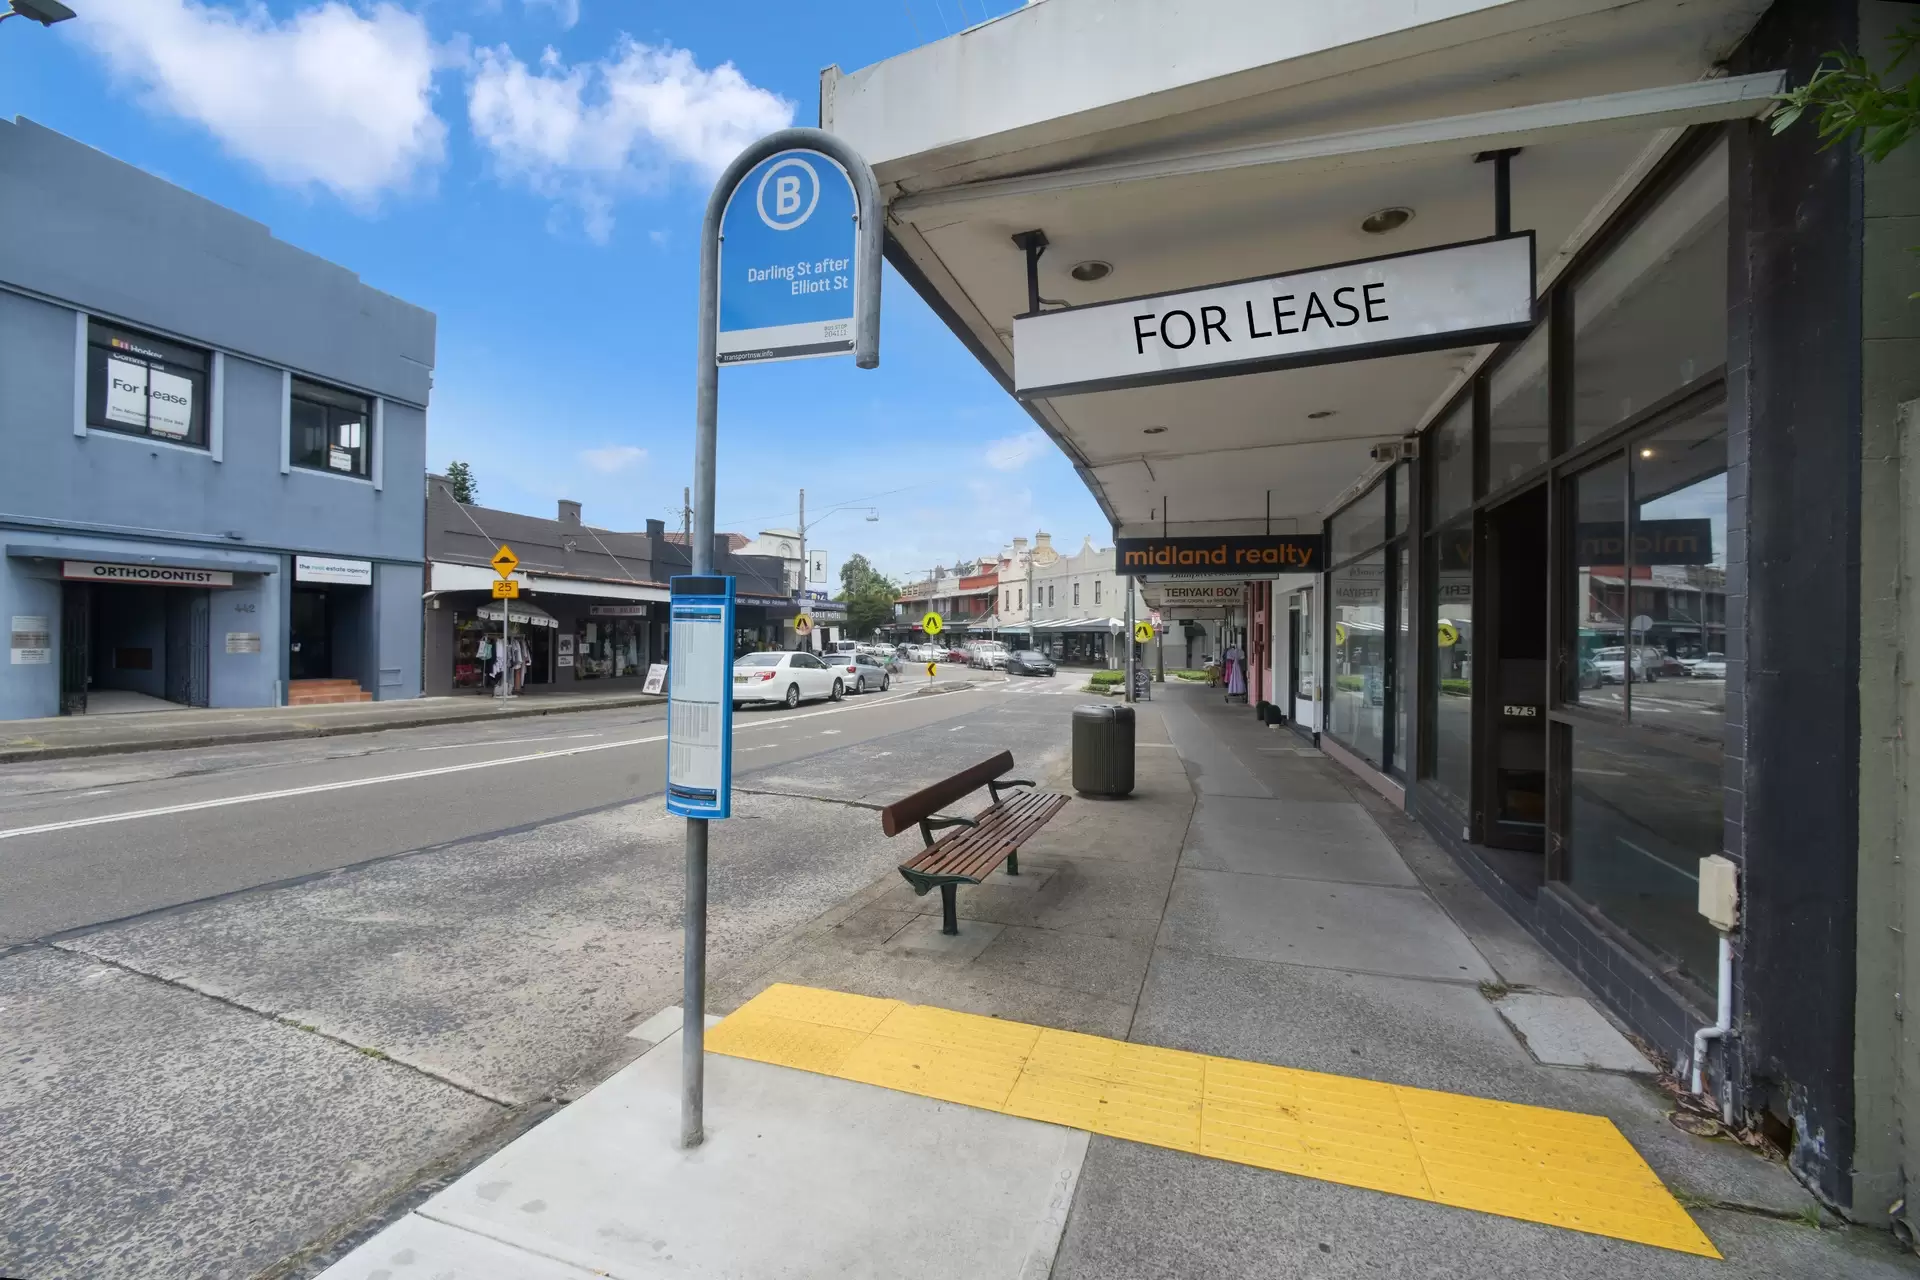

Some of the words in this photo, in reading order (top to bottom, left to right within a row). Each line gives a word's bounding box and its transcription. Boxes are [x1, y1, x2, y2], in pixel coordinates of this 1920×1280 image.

[776, 175, 801, 216] B
[748, 265, 795, 282] Darling
[797, 261, 811, 276] St
[814, 258, 849, 274] after
[791, 279, 830, 295] Elliott
[833, 275, 848, 290] St
[1133, 305, 1232, 354] FOR
[1246, 282, 1389, 338] LEASE
[130, 344, 164, 359] Hooker
[724, 350, 774, 361] transportnsw.info
[113, 378, 139, 393] For
[144, 385, 187, 406] Lease
[1125, 545, 1227, 565] midland
[1235, 543, 1312, 567] realty
[93, 565, 212, 582] ORTHODONTIST
[498, 582, 512, 592] 25
[1165, 587, 1213, 597] TERIYAKI
[1216, 587, 1239, 597] BOY
[1506, 706, 1534, 716] 475
